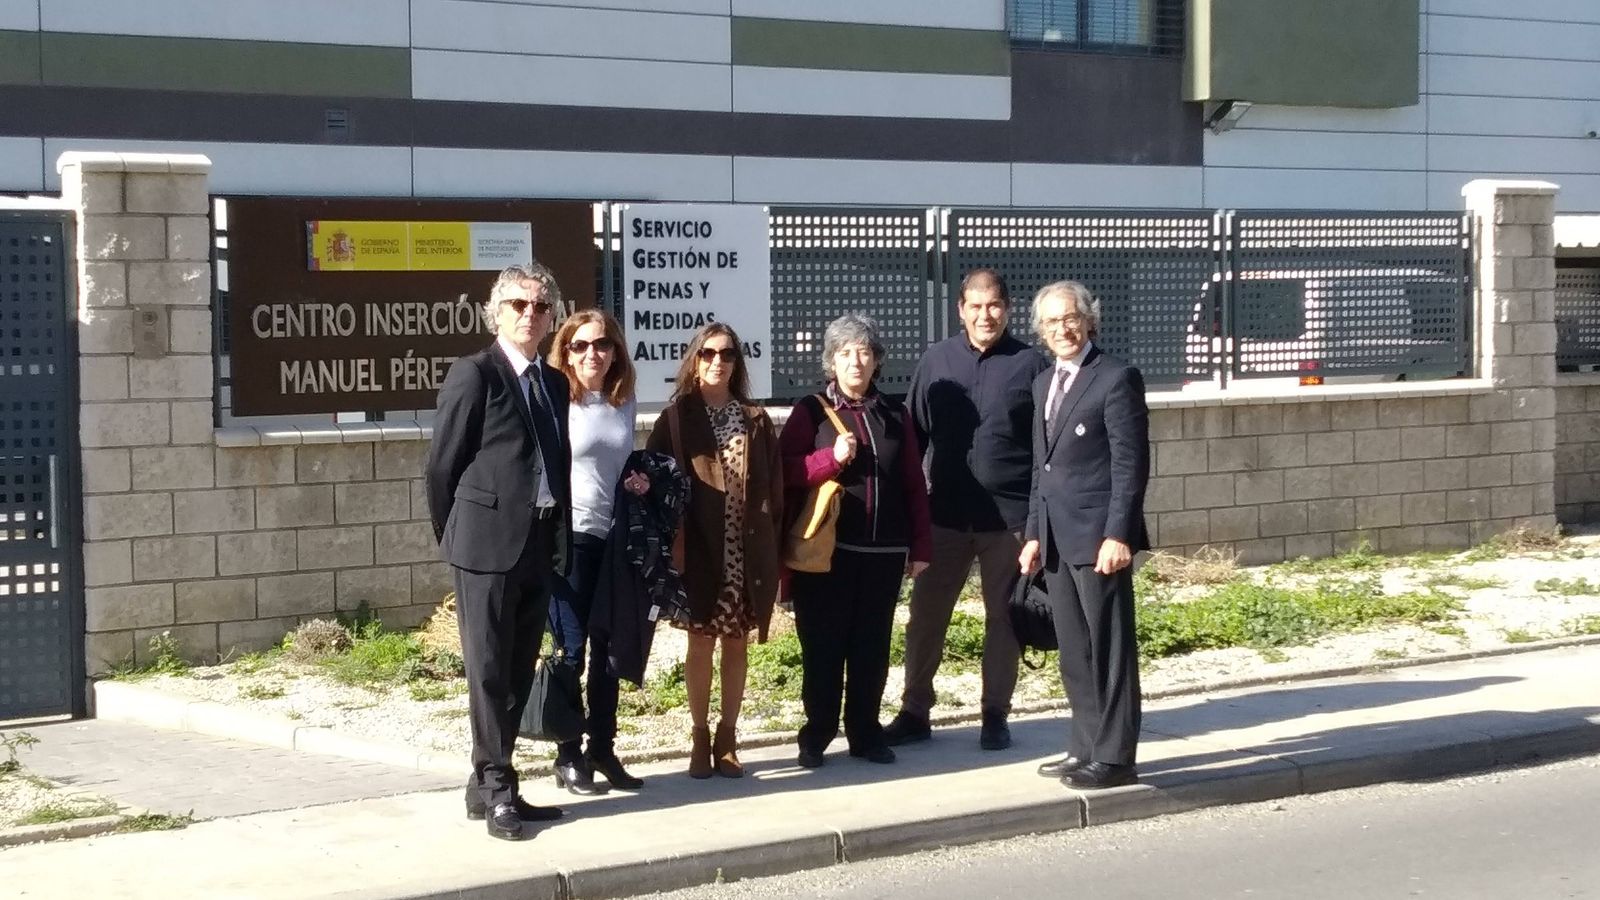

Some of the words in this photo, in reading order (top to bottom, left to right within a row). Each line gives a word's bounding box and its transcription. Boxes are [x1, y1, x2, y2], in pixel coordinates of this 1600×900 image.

[632, 217, 712, 239] SERVICIO
[632, 246, 711, 269] GESTIÓN
[716, 251, 739, 269] DE
[633, 279, 693, 300] PENAS
[699, 281, 710, 299] Y
[252, 302, 356, 339] CENTRO
[633, 310, 715, 331] MEDIDAS
[280, 356, 383, 394] MANUEL
